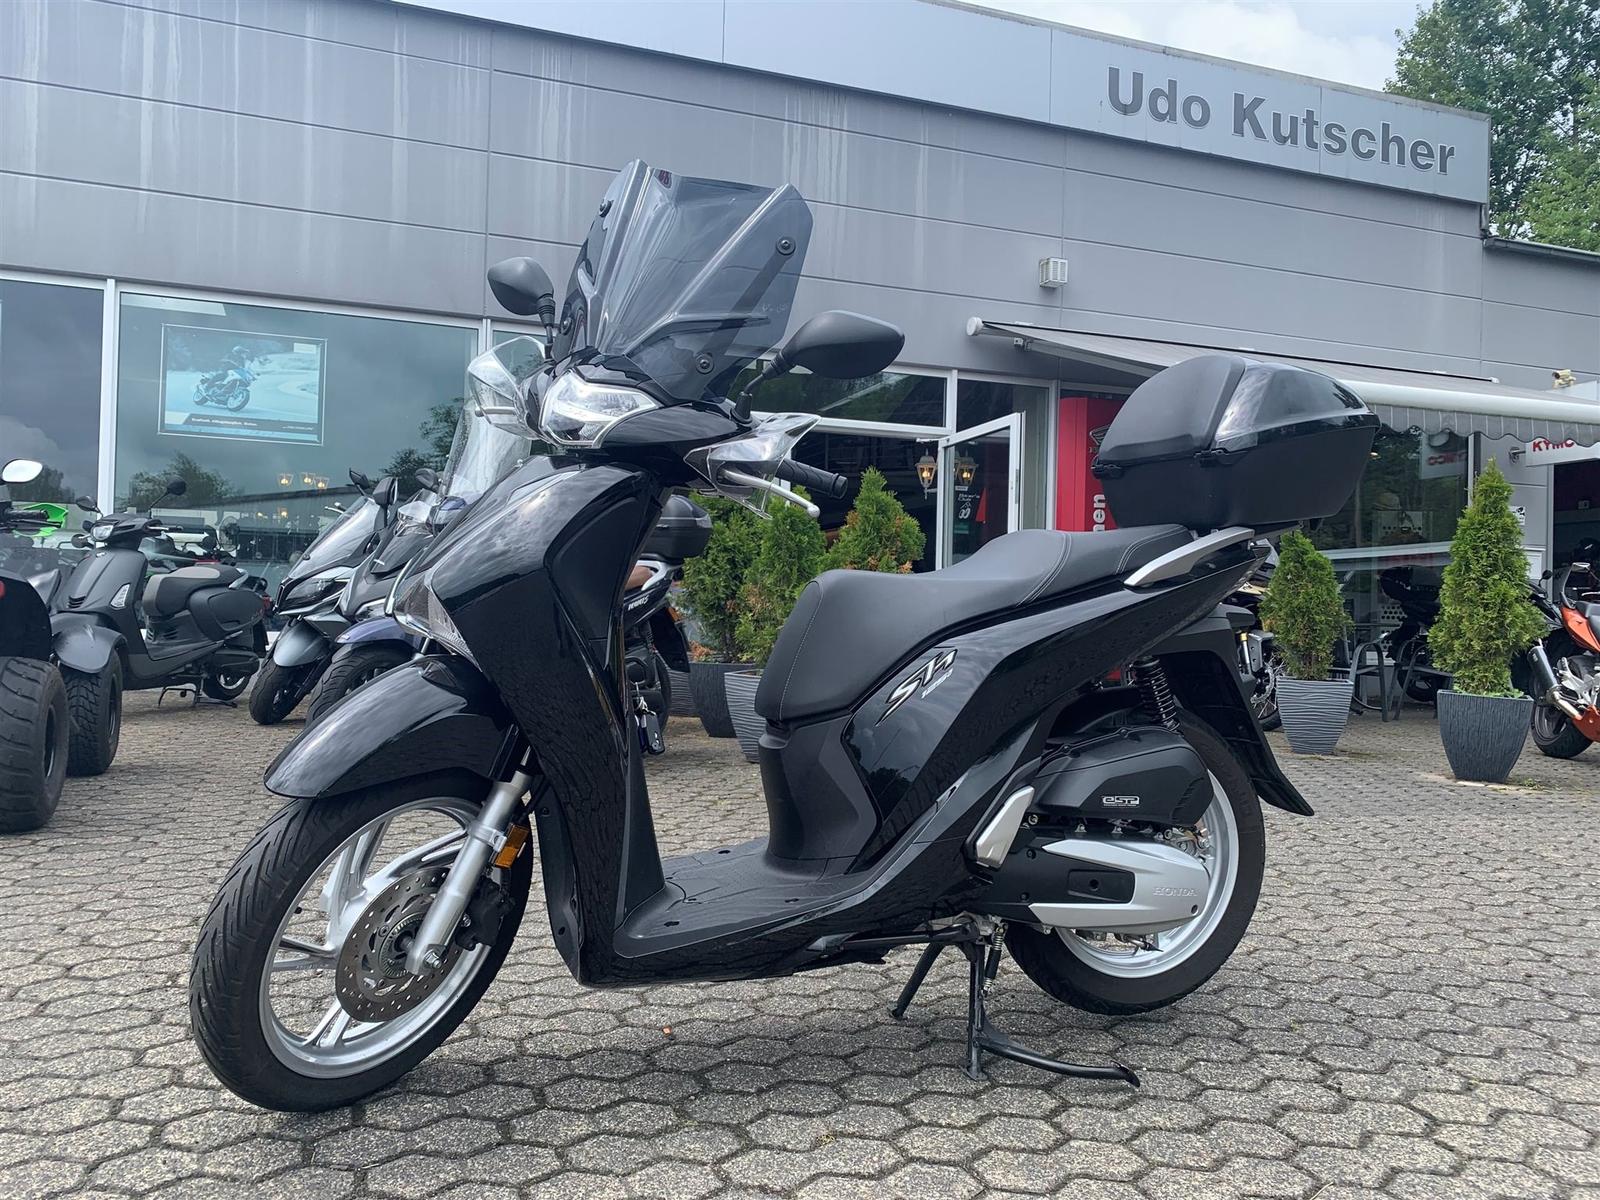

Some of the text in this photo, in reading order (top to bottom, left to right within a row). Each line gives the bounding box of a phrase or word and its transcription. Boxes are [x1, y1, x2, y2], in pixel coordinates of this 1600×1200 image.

[1107, 66, 1455, 175] Udo Kutscher
[1152, 887, 1198, 897] HONDA
